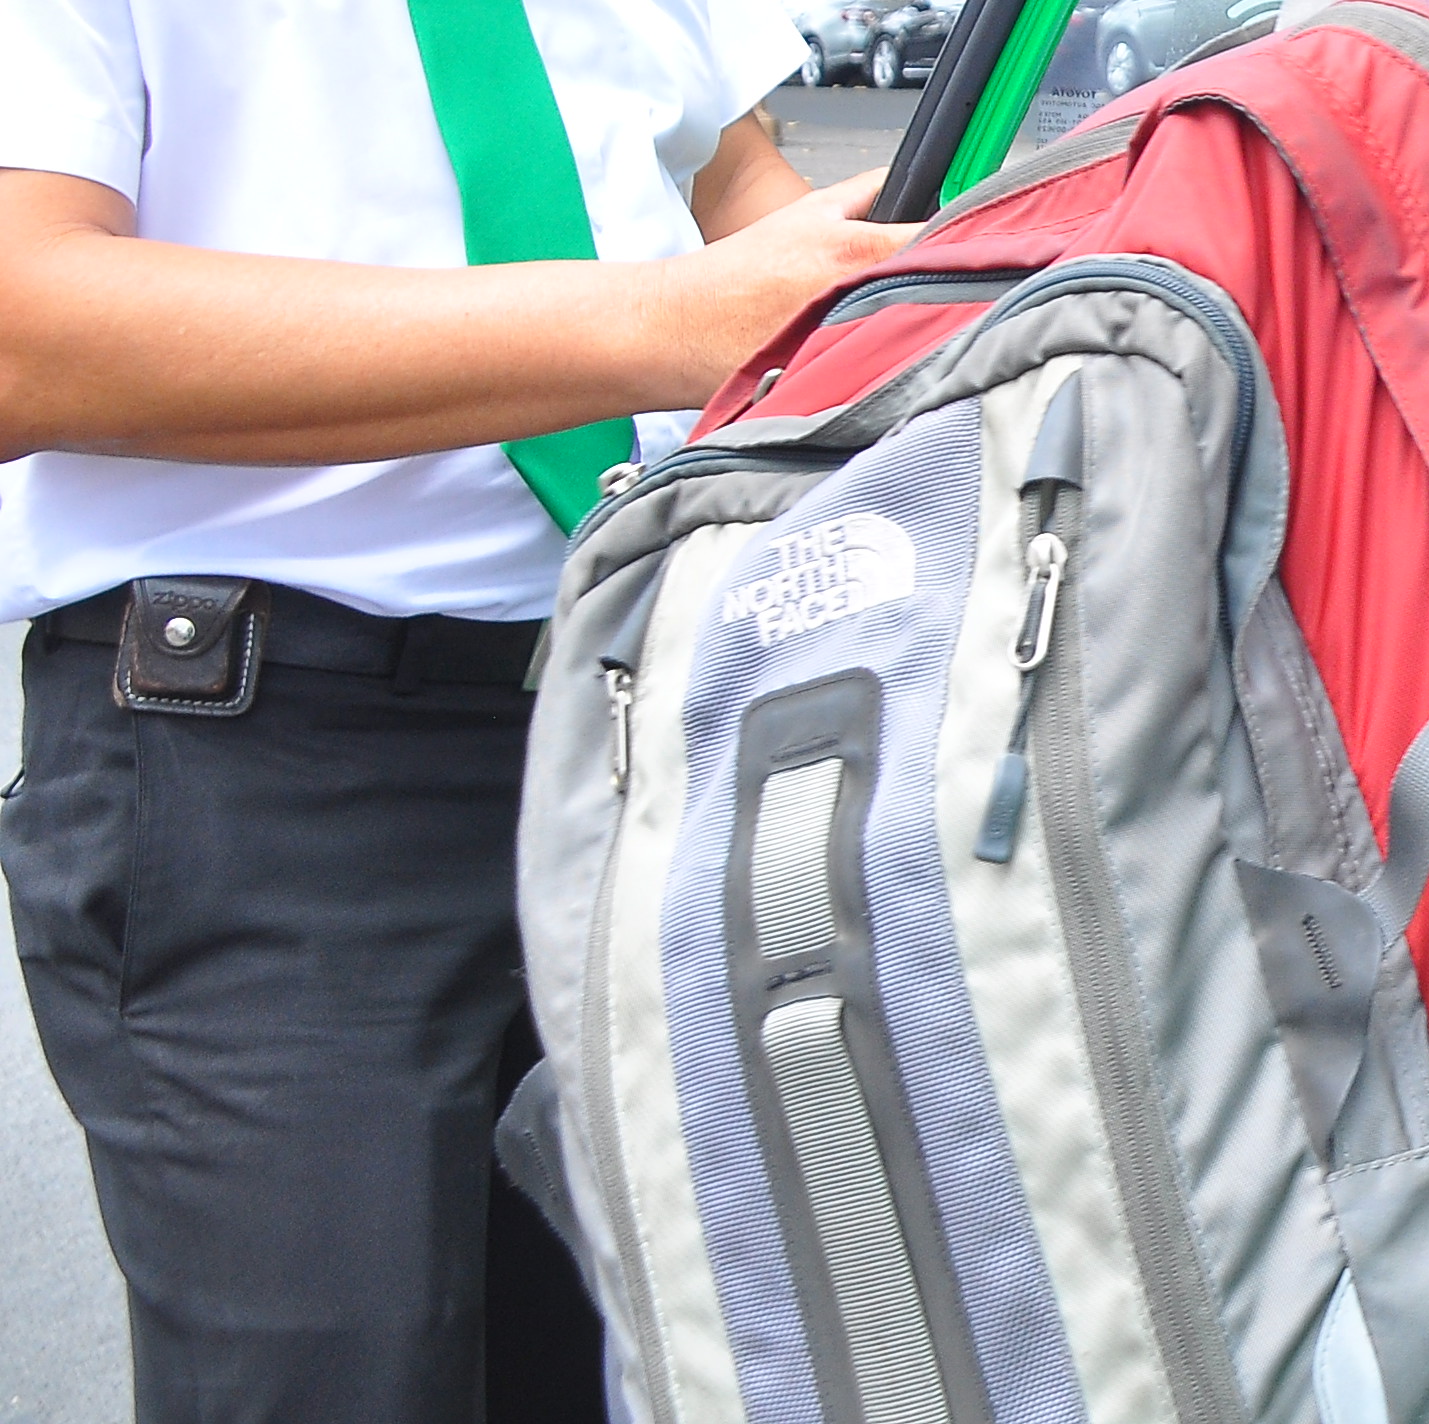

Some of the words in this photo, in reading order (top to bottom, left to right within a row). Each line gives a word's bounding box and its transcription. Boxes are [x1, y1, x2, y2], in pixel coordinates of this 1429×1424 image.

[769, 525, 846, 570] THE
[722, 554, 847, 622] NORTH
[757, 584, 848, 650] FACE
